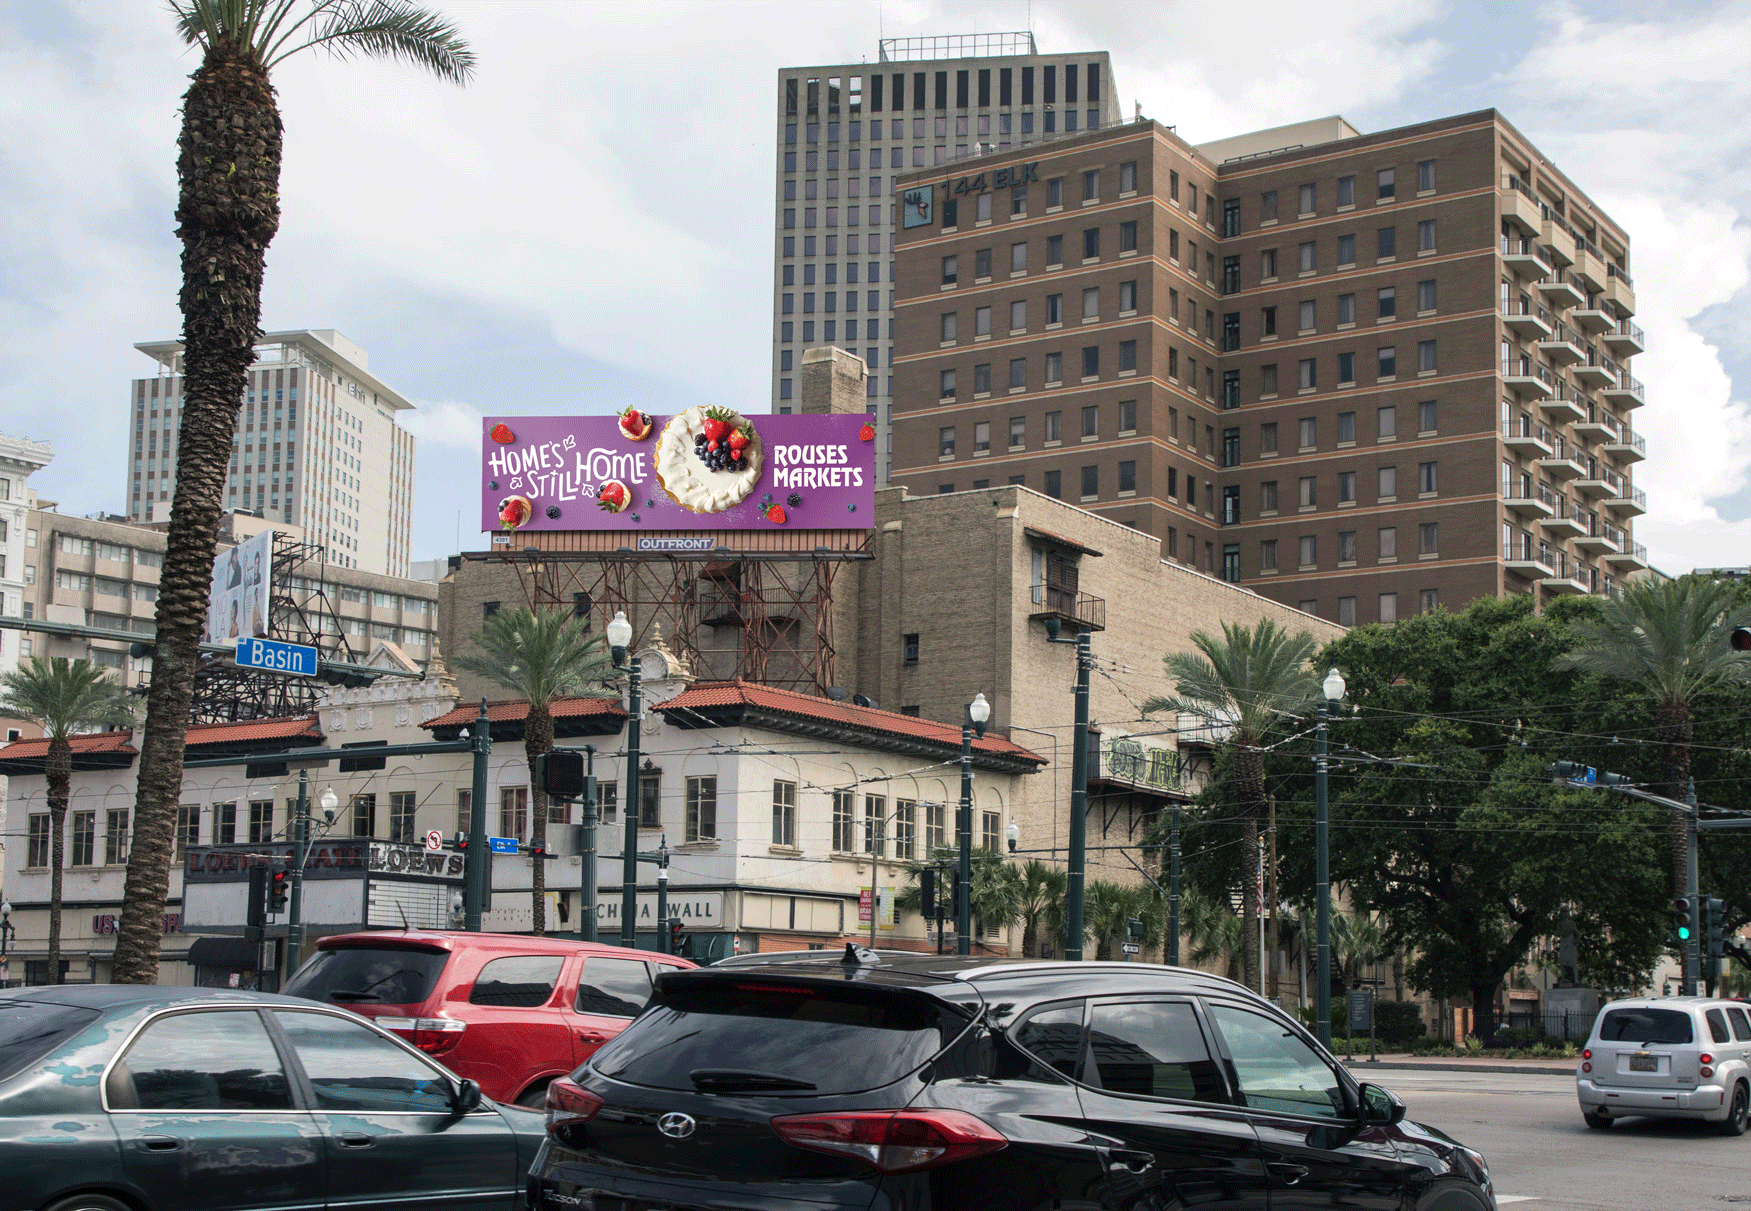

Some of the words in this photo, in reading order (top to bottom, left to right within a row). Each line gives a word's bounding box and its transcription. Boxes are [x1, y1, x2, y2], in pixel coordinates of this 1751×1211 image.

[941, 172, 987, 199] 144
[993, 162, 1038, 189] ELK
[488, 441, 564, 477] HOME'S
[575, 448, 648, 485] HOME
[774, 444, 848, 467] ROUSES
[773, 467, 864, 490] MARKETS
[640, 538, 713, 549] OUTFRONT
[251, 640, 303, 671] Basin
[370, 847, 464, 875] LOEWS
[597, 903, 650, 918] CHA
[666, 902, 713, 917] WALL
